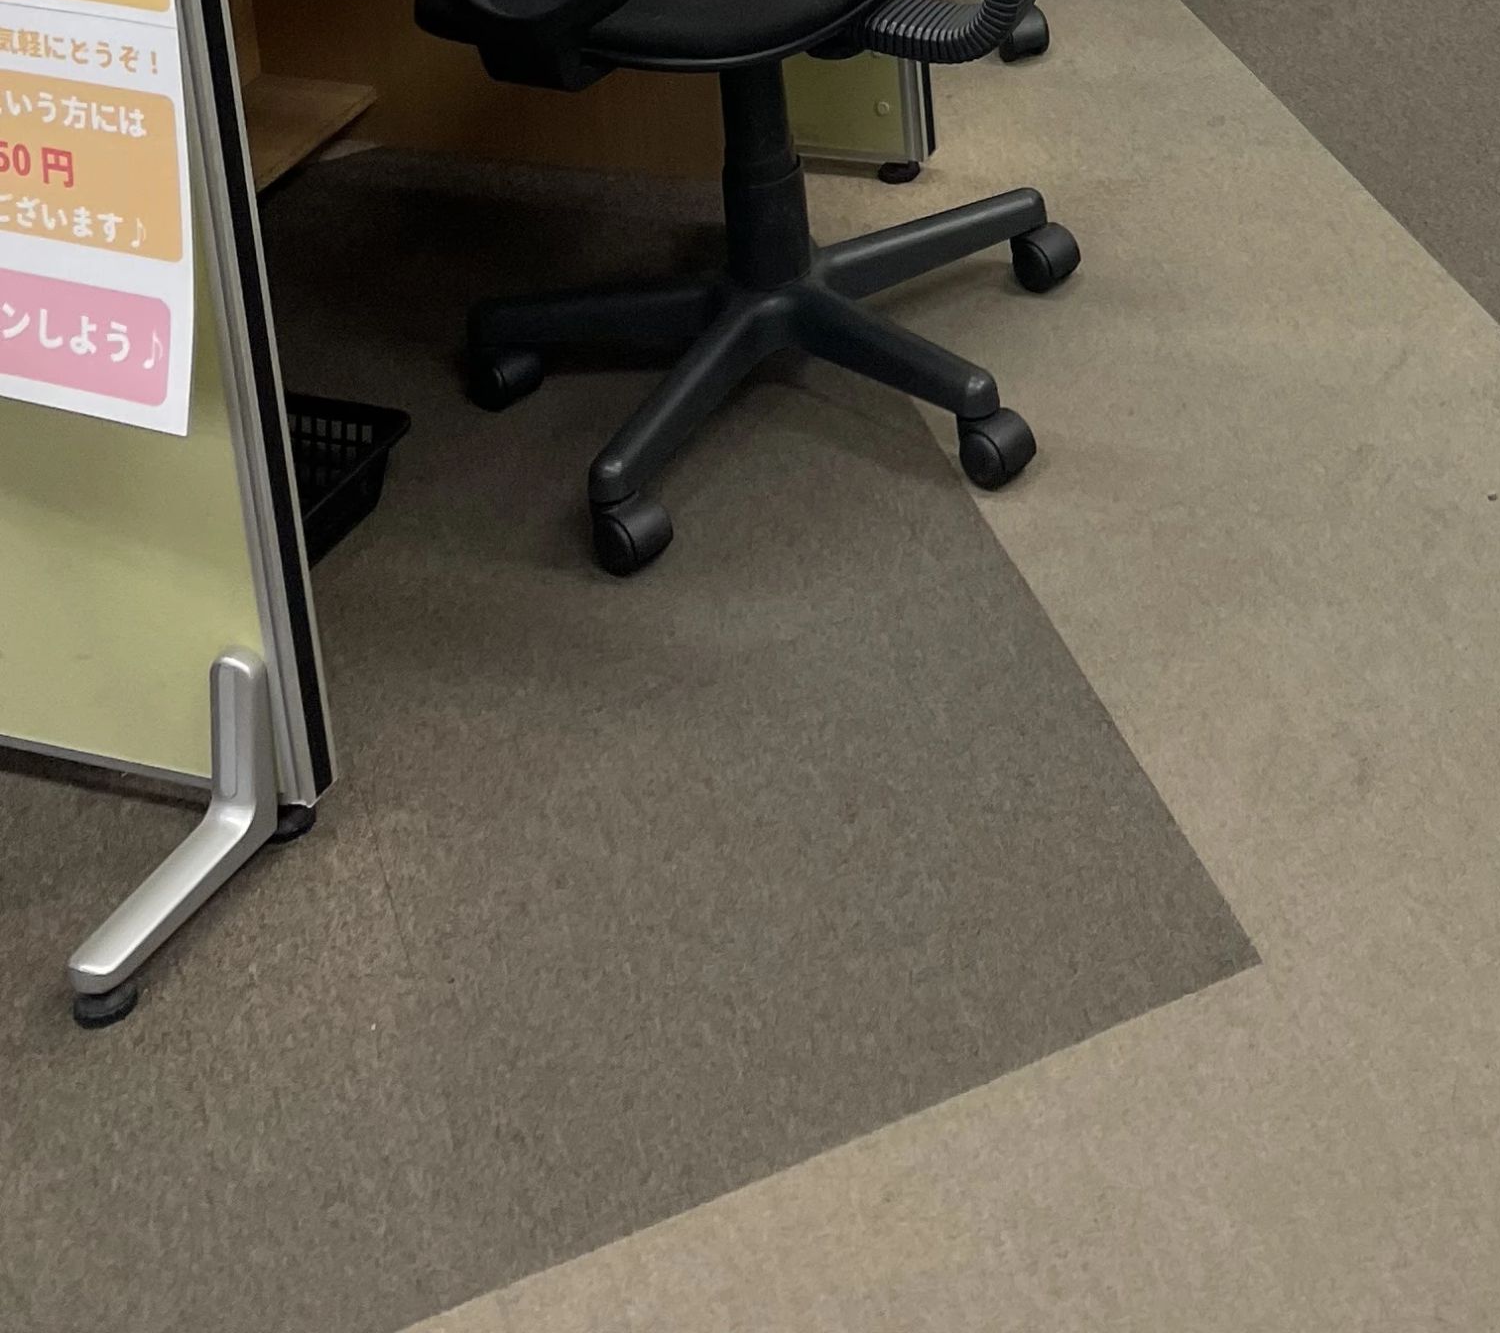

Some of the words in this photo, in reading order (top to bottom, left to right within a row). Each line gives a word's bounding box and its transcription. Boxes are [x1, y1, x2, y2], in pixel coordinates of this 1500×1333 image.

[0, 90, 147, 139] いう方には
